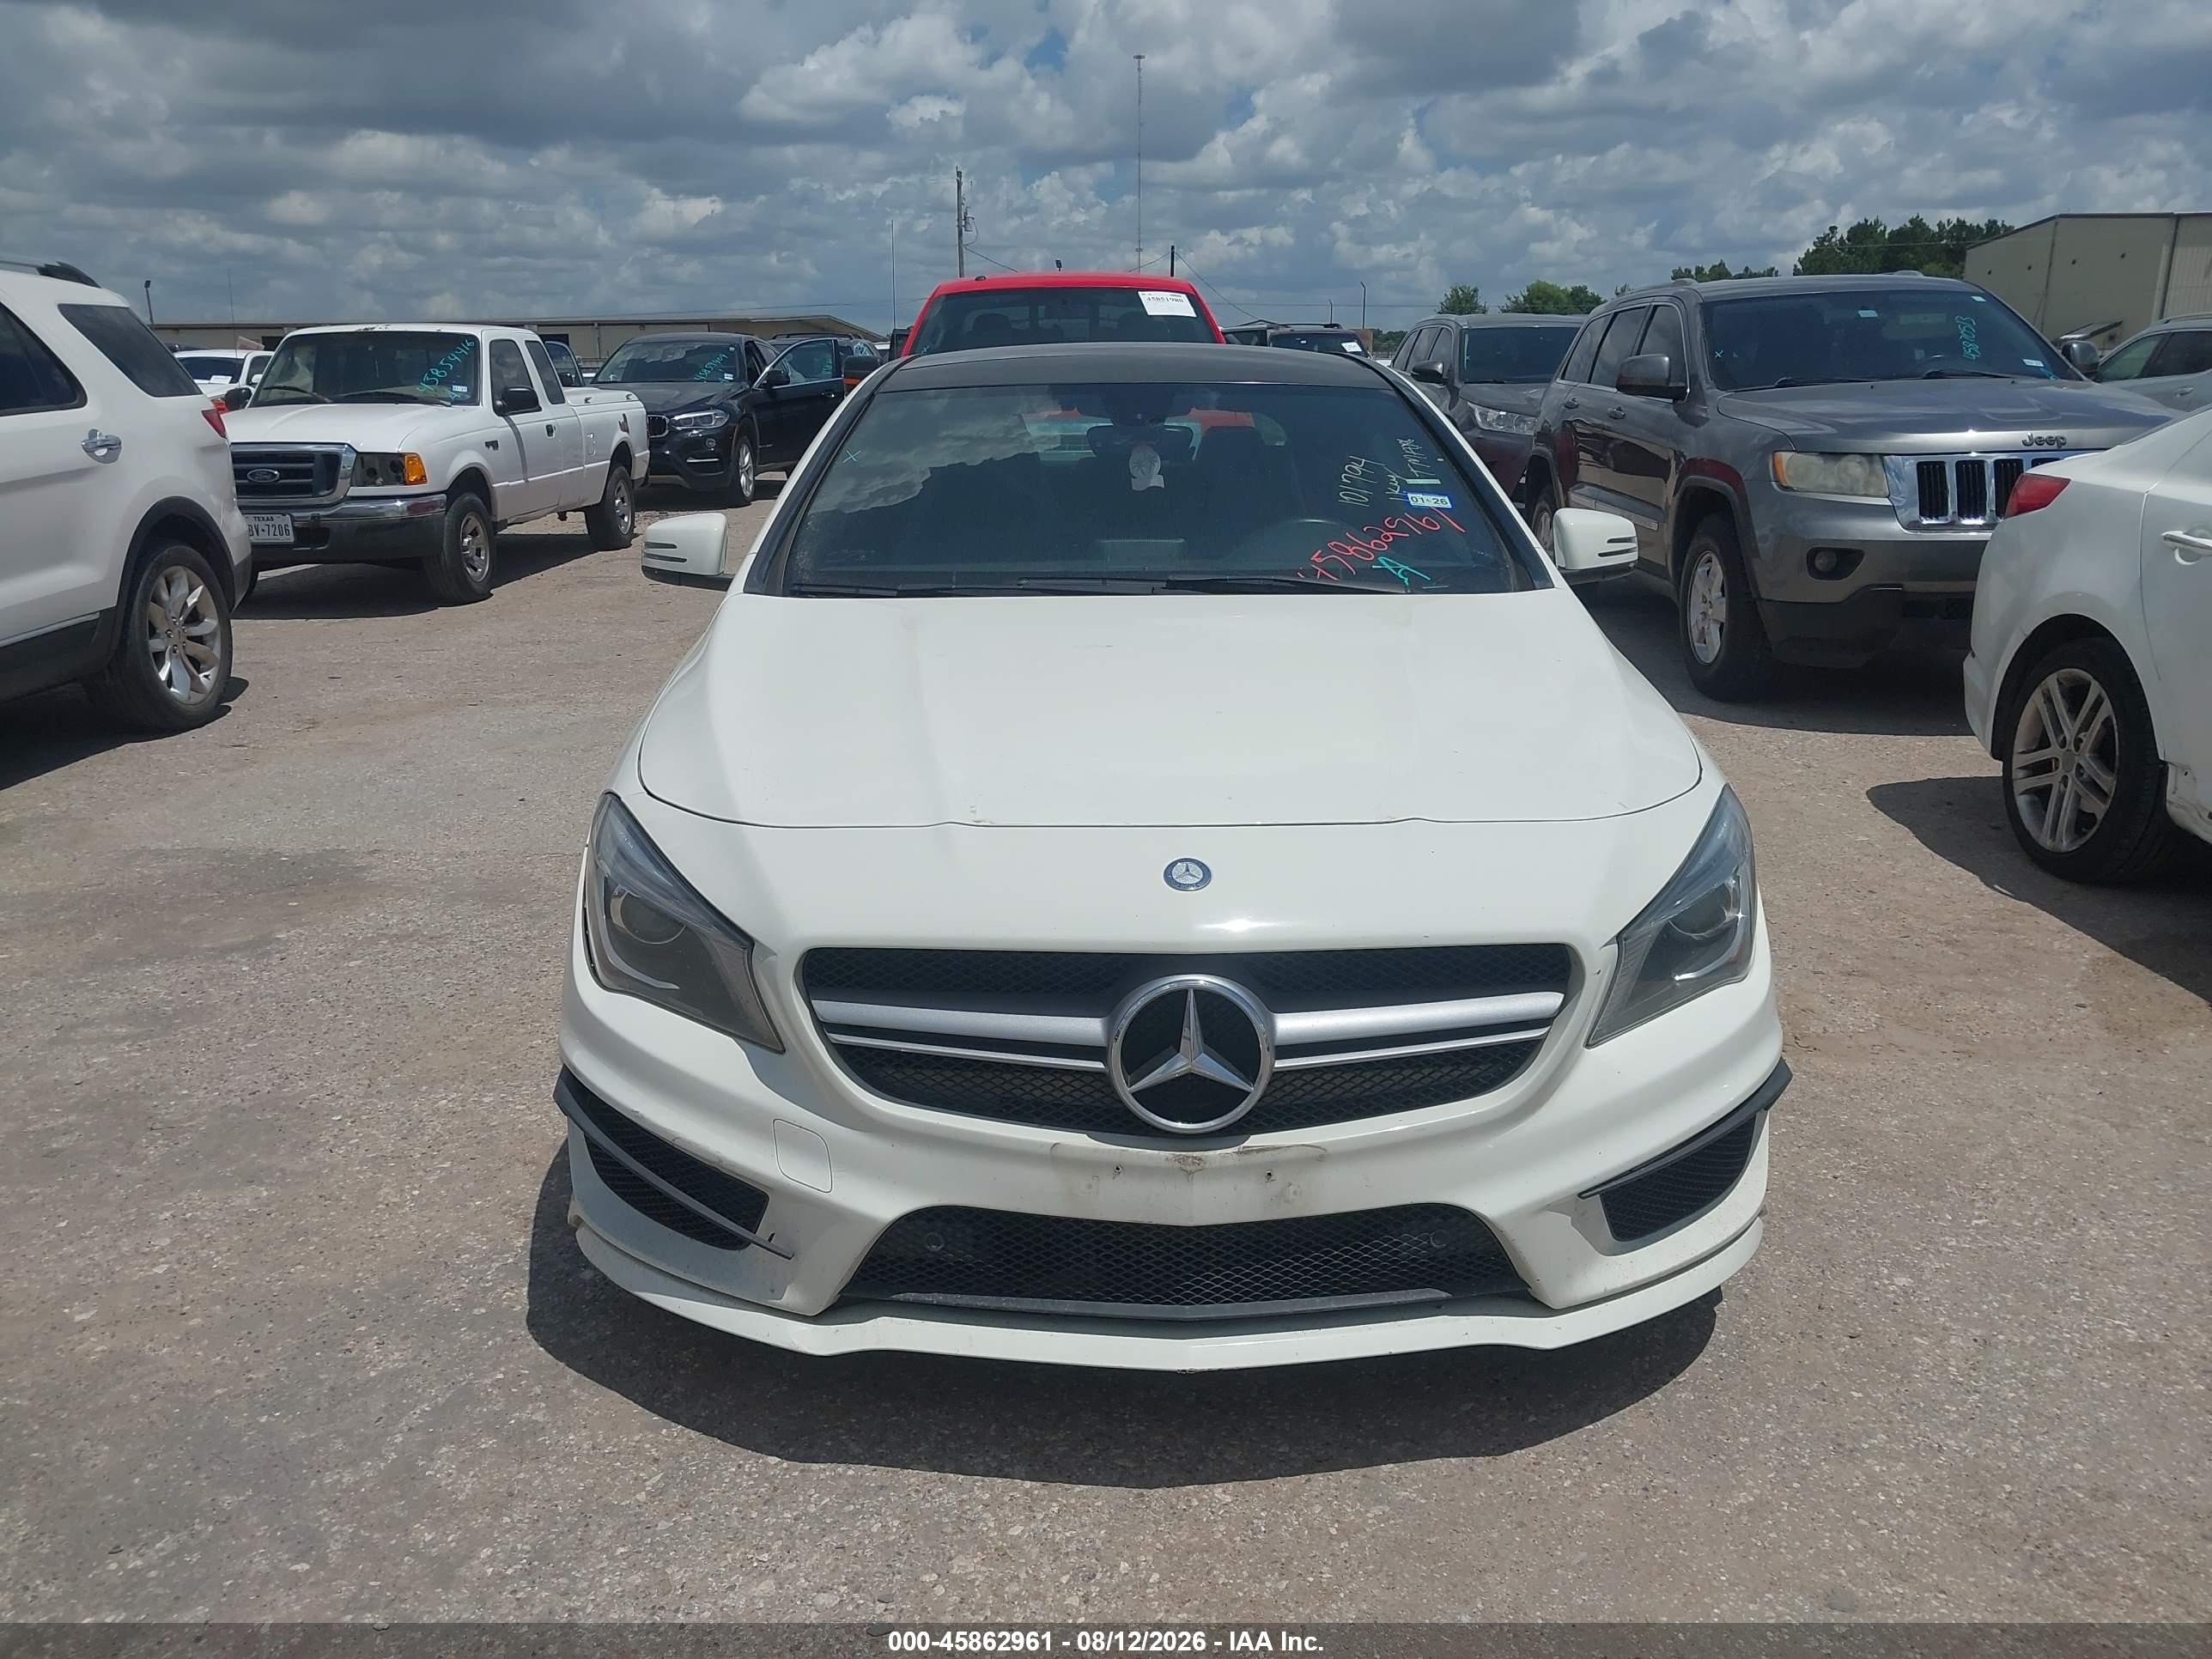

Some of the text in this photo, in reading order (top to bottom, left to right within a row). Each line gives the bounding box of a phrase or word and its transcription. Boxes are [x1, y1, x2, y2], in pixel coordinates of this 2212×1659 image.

[416, 339, 475, 392] 45854416
[2021, 432, 2067, 448] Jeep
[1338, 455, 1386, 507] 101794
[1297, 507, 1467, 580] 45862961
